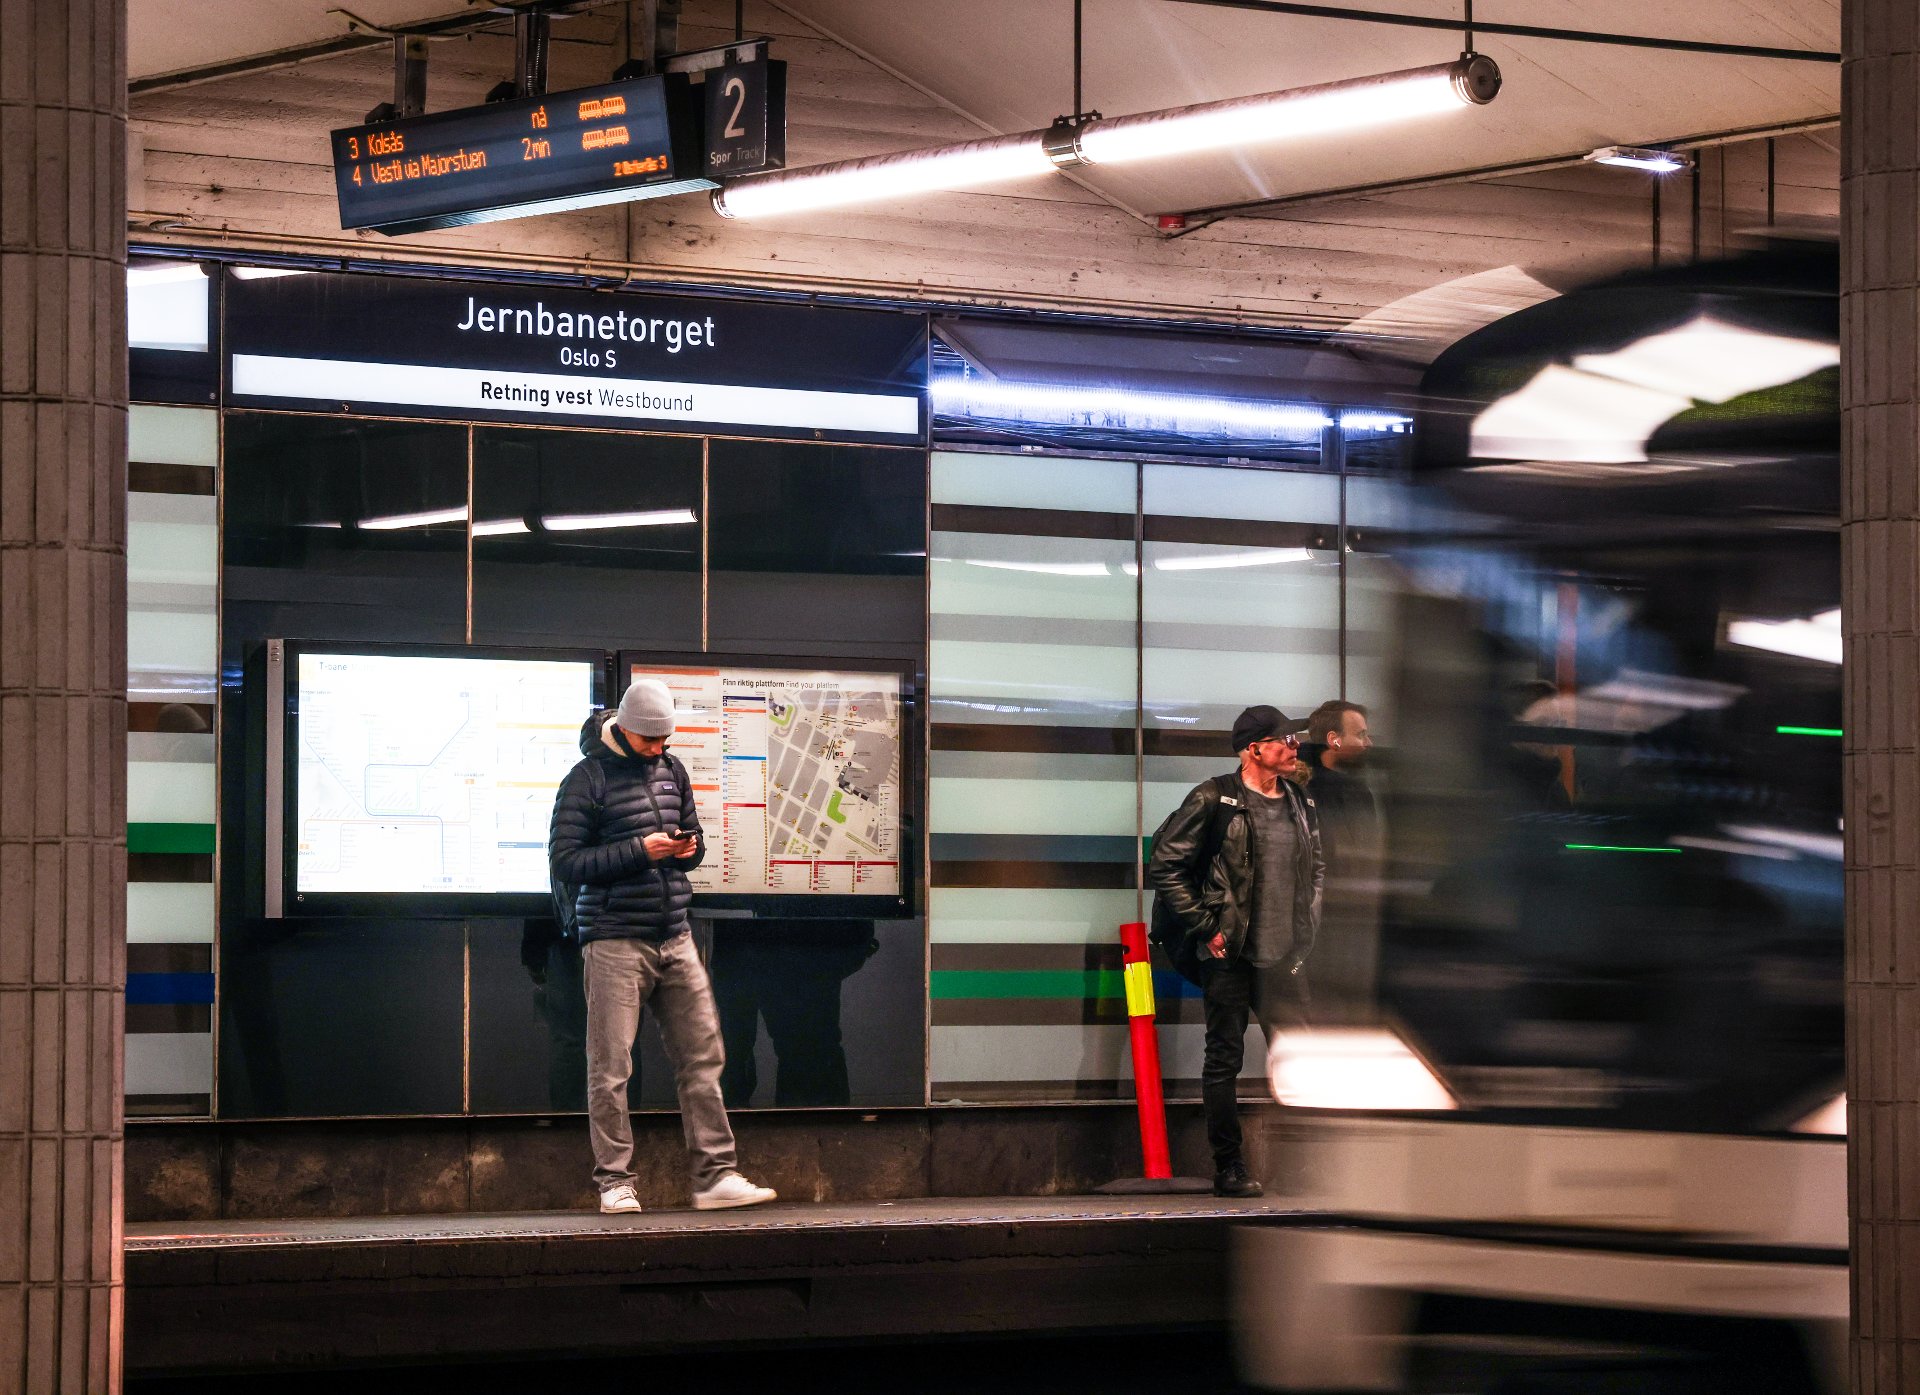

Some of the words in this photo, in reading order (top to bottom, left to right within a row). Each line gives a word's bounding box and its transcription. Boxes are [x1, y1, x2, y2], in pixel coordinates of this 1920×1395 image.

[724, 77, 746, 139] 2
[349, 137, 359, 159] 3
[367, 131, 404, 156] Kolsås
[531, 105, 548, 129] nå
[352, 164, 362, 187] 4
[370, 159, 403, 184] Vestli
[404, 159, 420, 179] via
[421, 148, 487, 177] Majorstuen
[710, 151, 732, 168] Spor
[736, 144, 761, 161] Track
[457, 297, 716, 354] Jernbanetorget
[560, 346, 600, 367] Oslo
[605, 349, 617, 369] S
[481, 381, 550, 407] Retning
[555, 389, 593, 406] vest
[598, 388, 694, 412] Westbound
[722, 678, 737, 687] Finn
[737, 679, 754, 688] riktig
[755, 679, 785, 689] plattform
